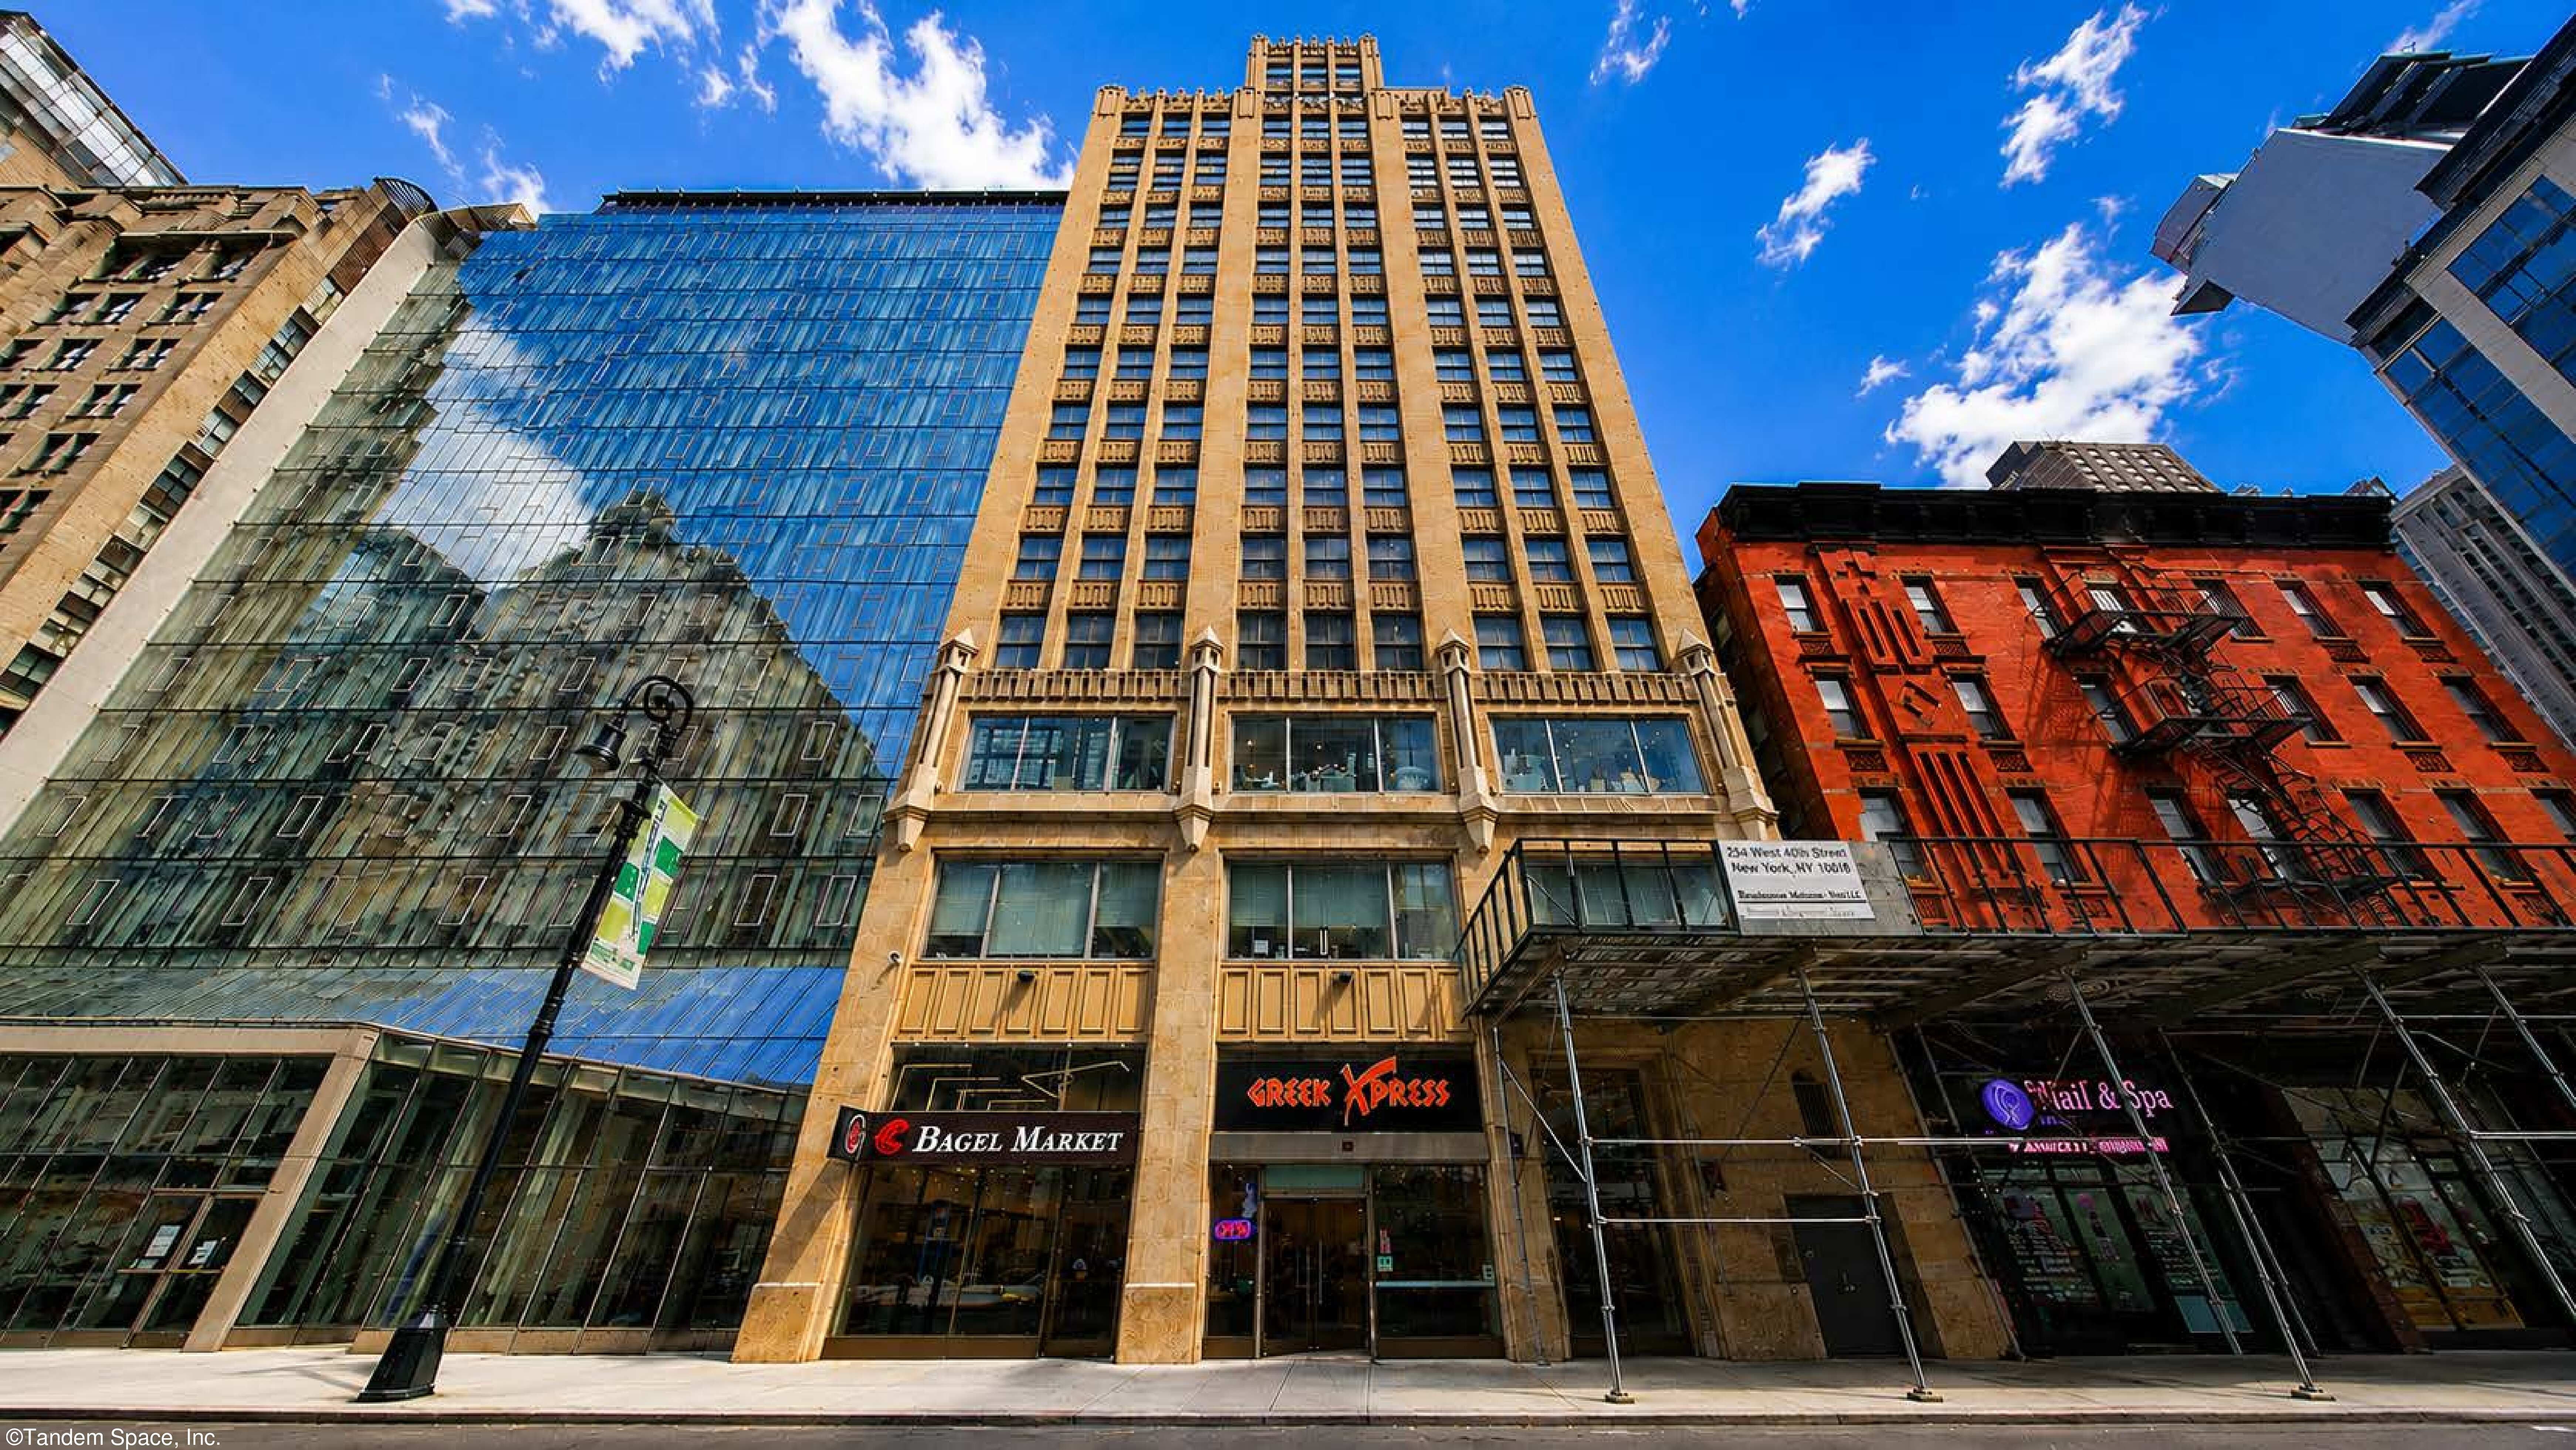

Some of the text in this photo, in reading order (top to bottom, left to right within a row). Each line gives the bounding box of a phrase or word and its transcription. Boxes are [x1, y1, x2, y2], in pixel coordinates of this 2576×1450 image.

[1750, 845, 1781, 857] West
[1783, 846, 1810, 857] 40th
[1811, 845, 1848, 858] Street
[1731, 862, 1758, 873] New
[1796, 862, 1814, 873] NY
[1246, 1055, 1452, 1126] GREEK XPRESS
[2098, 1081, 2121, 1109] &
[2121, 1079, 2174, 1118] Spa
[912, 1125, 1125, 1153] BAGEL MARKET
